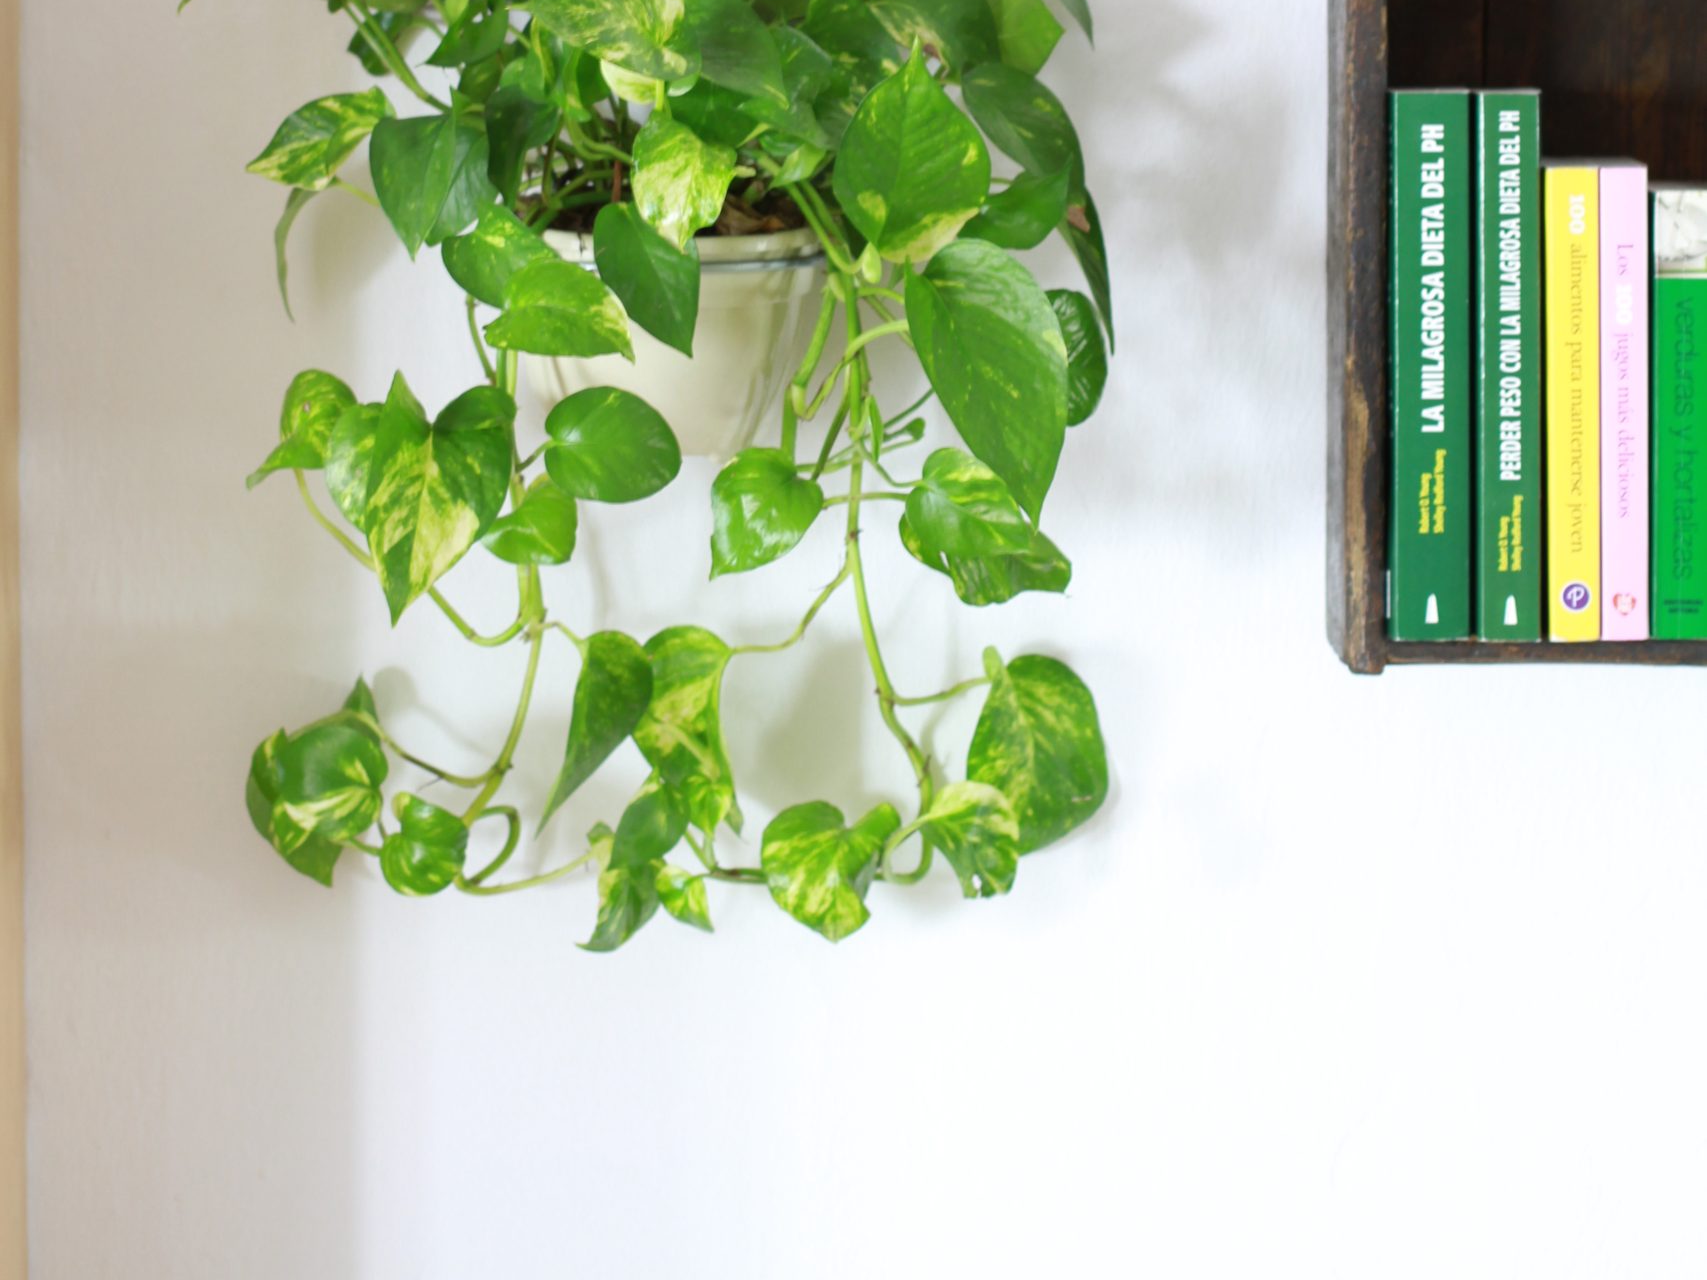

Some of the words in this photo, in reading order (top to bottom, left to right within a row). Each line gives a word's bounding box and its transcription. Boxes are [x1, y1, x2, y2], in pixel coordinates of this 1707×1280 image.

[1420, 123, 1445, 153] PH
[1498, 110, 1520, 132] PH
[1499, 135, 1520, 165] DEL
[1420, 157, 1445, 199] DEL
[1499, 168, 1521, 215] DIETA
[1420, 203, 1445, 266] DIETA
[1568, 193, 1586, 236] 100
[1499, 217, 1521, 311] MILAGROSA
[1616, 243, 1634, 278] Los
[1570, 243, 1588, 335] alimentos
[1615, 283, 1633, 325] 100
[1420, 271, 1445, 400] MILAGROSA
[1499, 314, 1521, 336] LA
[1500, 338, 1521, 373] CON
[1564, 341, 1582, 382] para
[1612, 333, 1634, 381] jugos
[1674, 296, 1700, 416] verduras
[1500, 376, 1521, 417] PESO
[1617, 387, 1634, 424] más
[1421, 404, 1445, 432] LA
[1668, 424, 1693, 442] y
[1500, 420, 1521, 480] PERDER
[1570, 388, 1583, 496] mantenerse
[1617, 429, 1635, 518] deliciosos
[1565, 503, 1587, 554] joven
[1672, 449, 1699, 581] hortalizas
